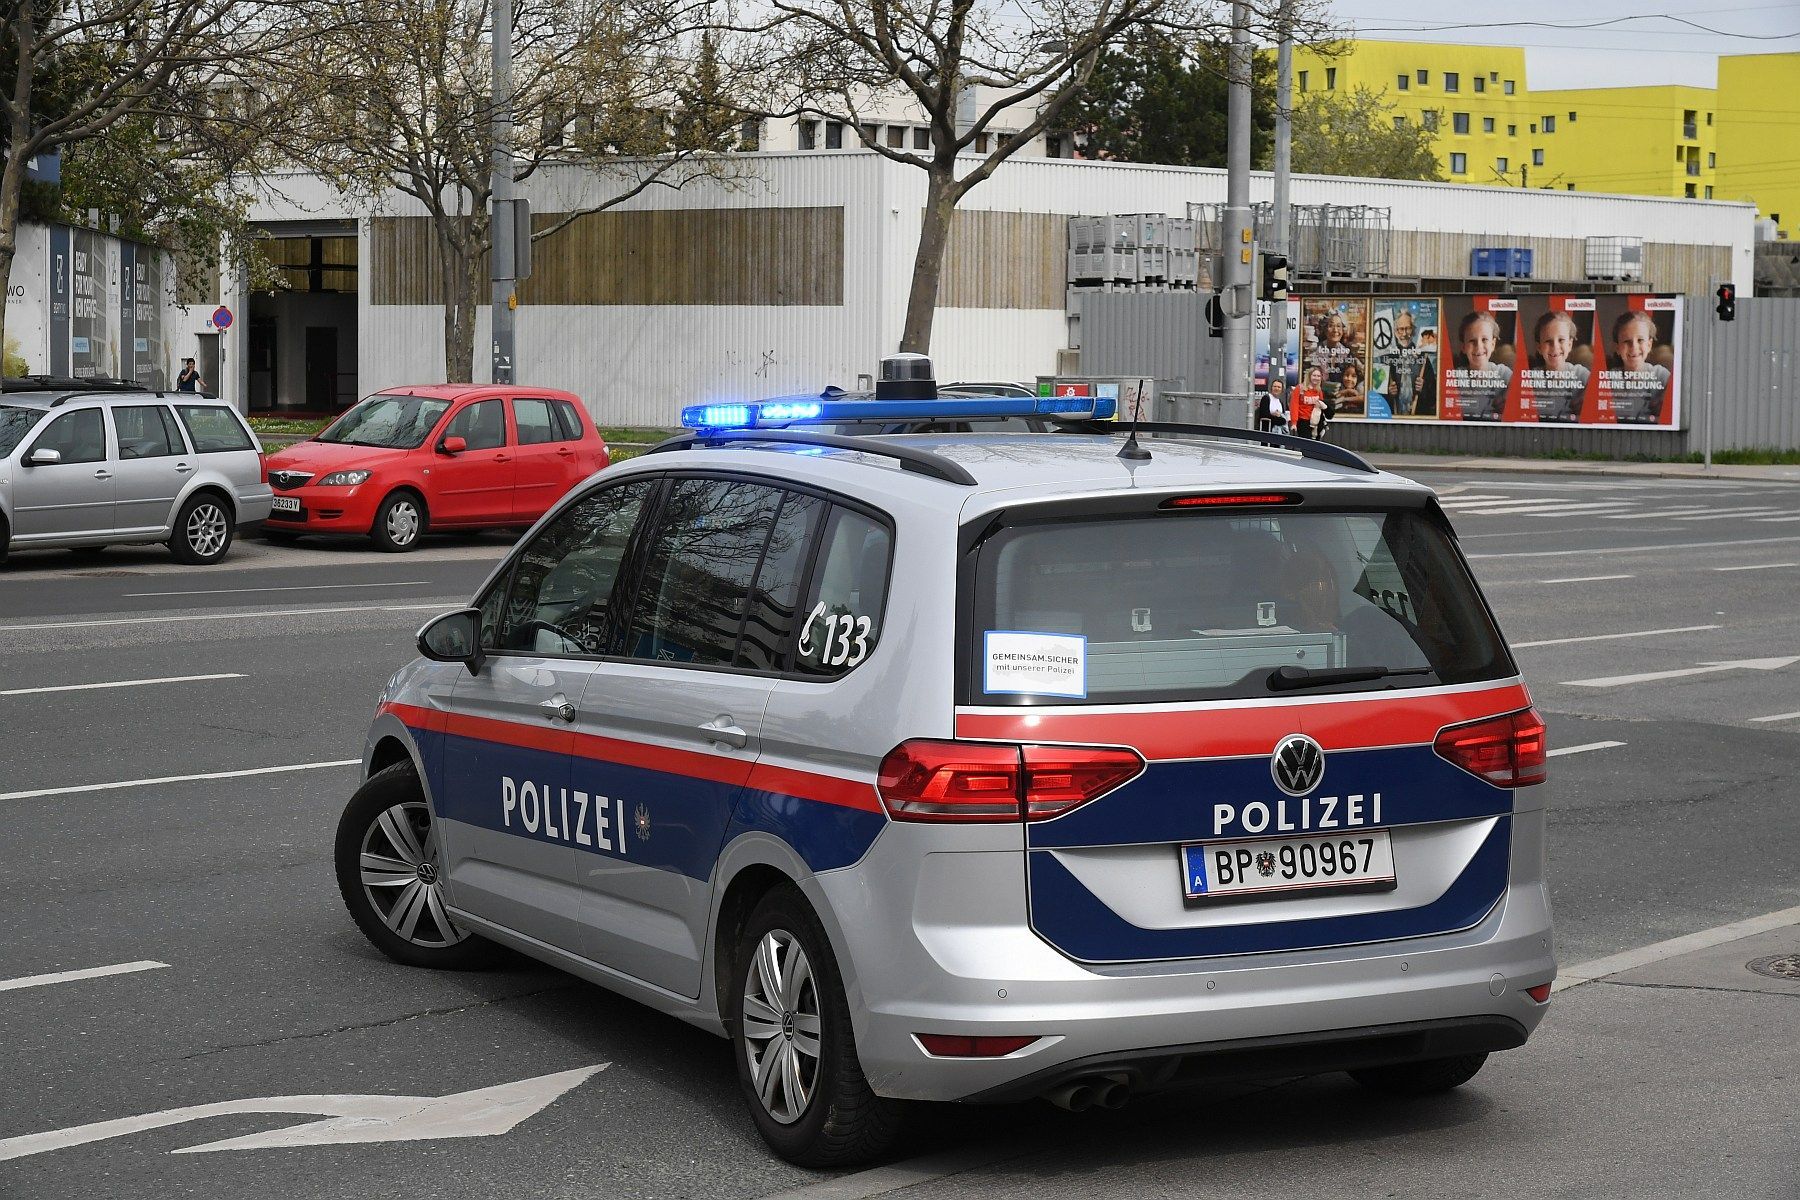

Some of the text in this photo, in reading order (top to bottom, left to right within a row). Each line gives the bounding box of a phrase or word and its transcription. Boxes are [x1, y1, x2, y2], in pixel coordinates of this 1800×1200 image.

[1318, 346, 1351, 357] Ich gebe
[1389, 346, 1421, 357] Ich gebe
[1446, 369, 1501, 379] DEINE SPENDE.
[1521, 369, 1578, 379] DEINE SPENDE.
[1598, 370, 1658, 380] DEINE SPENDE.
[1446, 379, 1508, 388] MEINE BILDUNG.
[1521, 380, 1585, 389] MEINE BILDUNG.
[1598, 380, 1665, 390] MEINE BILDUNG.
[822, 614, 871, 667] 133
[992, 652, 1079, 665] GEMEINSAM.SICHER
[1012, 664, 1045, 673] unserer
[1047, 665, 1075, 675] Polizei
[502, 776, 627, 854] POLIZEI
[1213, 792, 1381, 835] POLIZEI
[1214, 848, 1253, 885] BP
[1278, 838, 1374, 880] 90967
